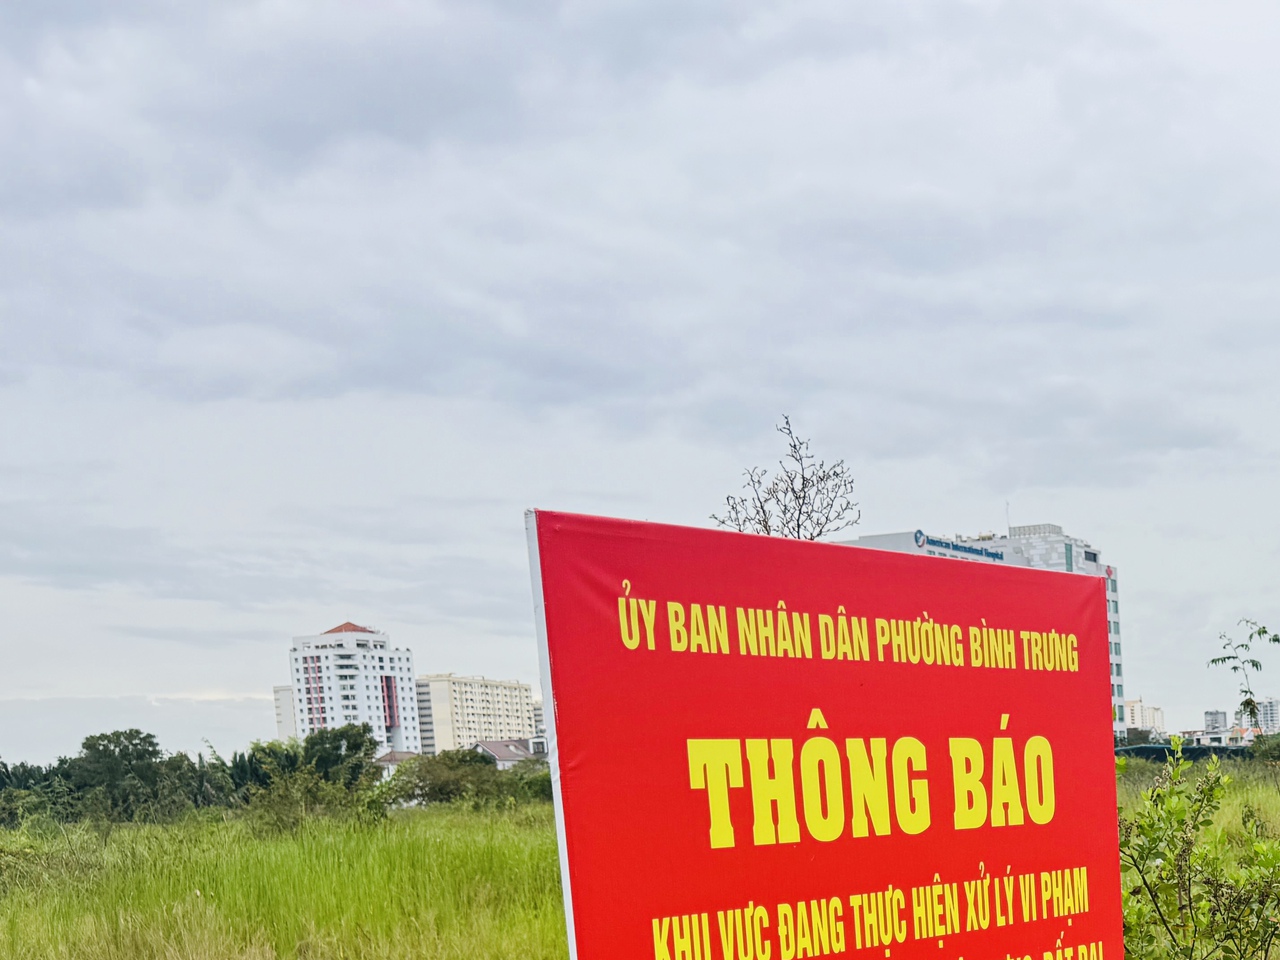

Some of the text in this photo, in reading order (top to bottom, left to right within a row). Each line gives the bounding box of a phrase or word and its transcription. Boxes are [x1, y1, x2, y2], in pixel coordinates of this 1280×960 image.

[618, 579, 1079, 672] ỦY BAN NHÂN DÂN PHƯỜNG BÌNH TRƯNG
[687, 708, 1056, 849] THÔNG BÁO
[850, 884, 907, 957] THỰC
[912, 873, 960, 948] HIỆN
[964, 861, 990, 931] XỬ
[995, 865, 1014, 927] LÝ
[1019, 873, 1037, 922] VI
[1040, 867, 1089, 926] PHẠM
